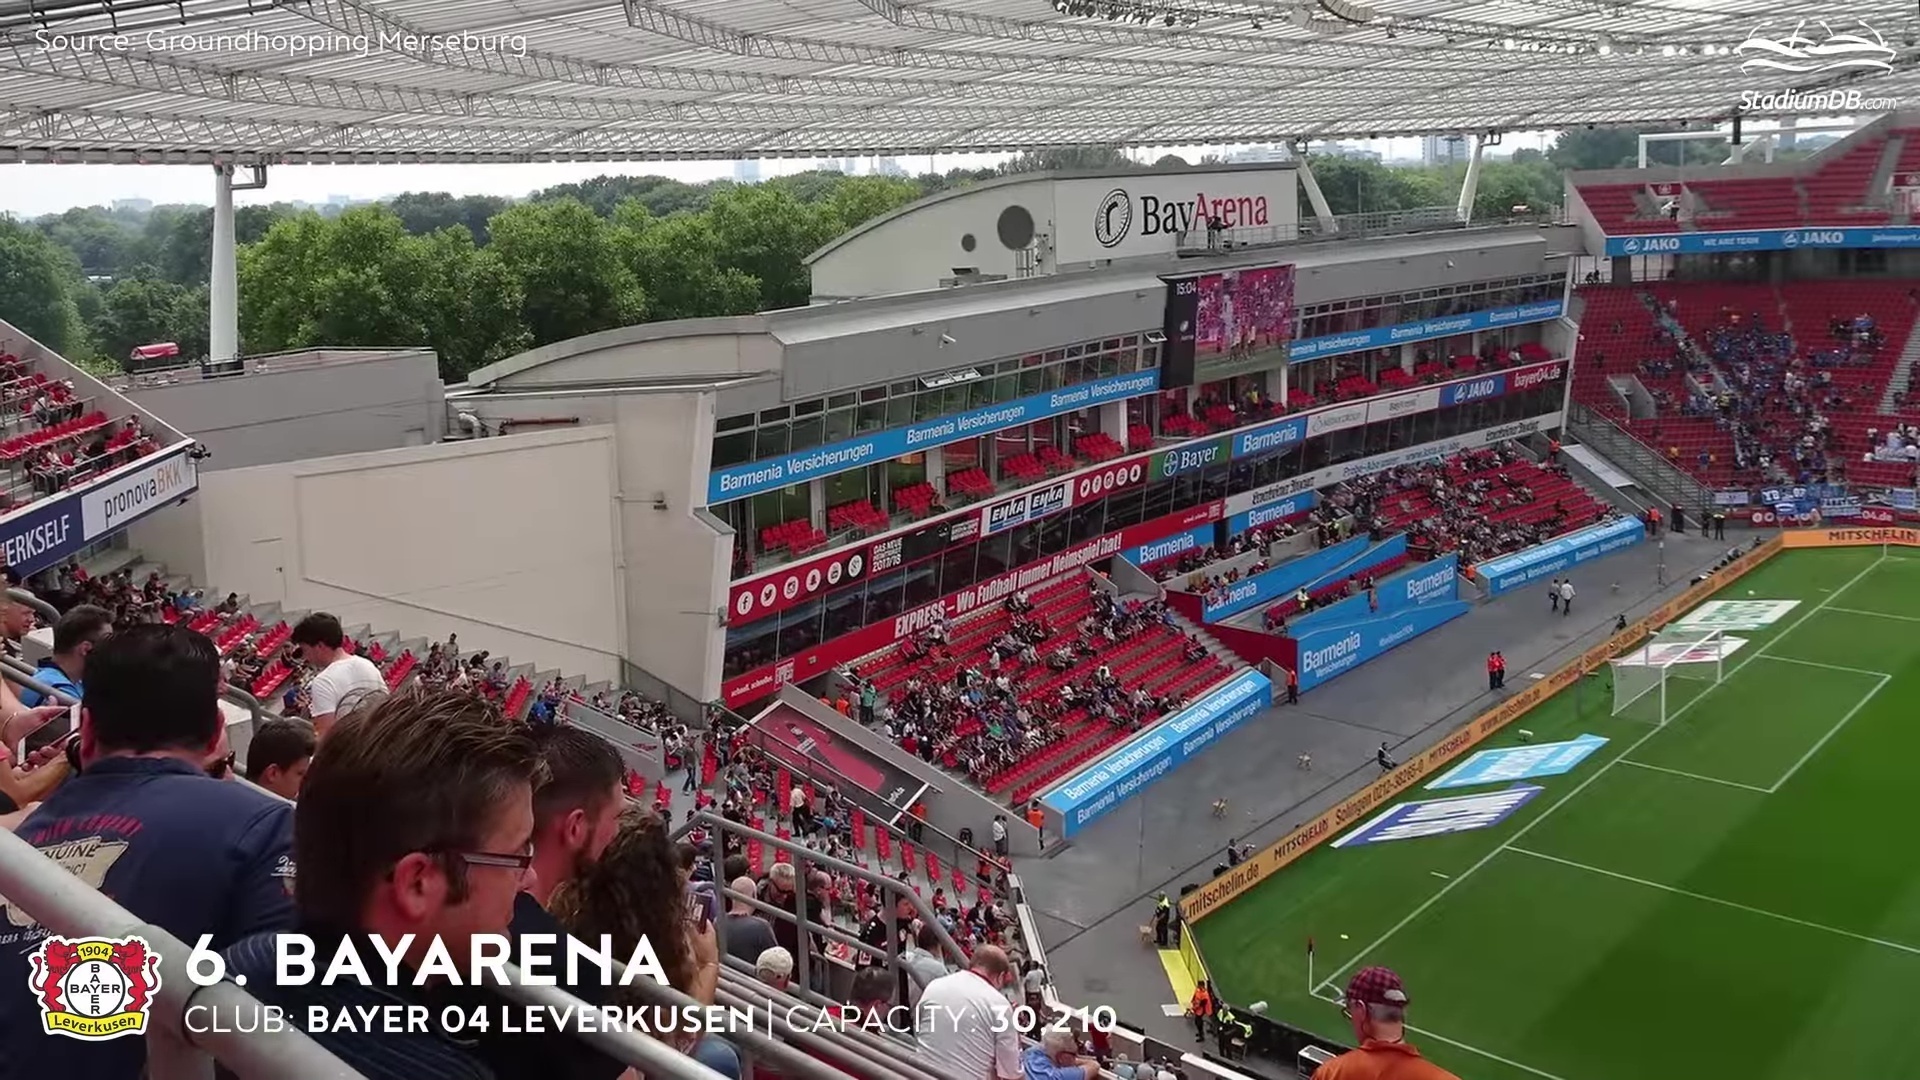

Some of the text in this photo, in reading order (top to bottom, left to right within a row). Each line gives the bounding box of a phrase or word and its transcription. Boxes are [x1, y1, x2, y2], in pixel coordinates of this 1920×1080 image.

[1140, 192, 1269, 243] BayArena
[1642, 238, 1680, 251] JAKO
[1801, 231, 1844, 244] JAKO
[1050, 376, 1154, 408] Barmenia Versicherungen
[1467, 379, 1495, 399] JAKO
[907, 404, 1025, 445] Barmenia Versicherungen
[1243, 424, 1298, 453] Barmenia
[720, 443, 873, 492] Barmenia Versicherungen
[1180, 446, 1219, 469] Bayer
[104, 460, 182, 528] pronovaBKK
[1249, 499, 1296, 527] Barmenia
[0, 514, 70, 567] ERKSELF
[1139, 532, 1194, 563] Barmenia
[1829, 530, 1917, 542] MITSCHELIN
[895, 600, 946, 638] EXPRESS
[957, 589, 976, 613] Wo
[976, 576, 1017, 607] Fußball
[1018, 566, 1051, 588] immer
[1052, 538, 1100, 576] Heimspiel
[1100, 532, 1122, 555] hat!
[1407, 564, 1454, 599] Barmenia
[1303, 631, 1361, 672] Barmenia
[1063, 679, 1256, 800] Barmenia Versicherungen Barmenia Versicherungen
[1077, 790, 1115, 824] Barmenia
[1117, 756, 1172, 797] Versicherungen
[1274, 818, 1329, 860] MITSCHELIN
[1429, 729, 1471, 762] MITSCHELIN
[44, 844, 100, 860] NUINE
